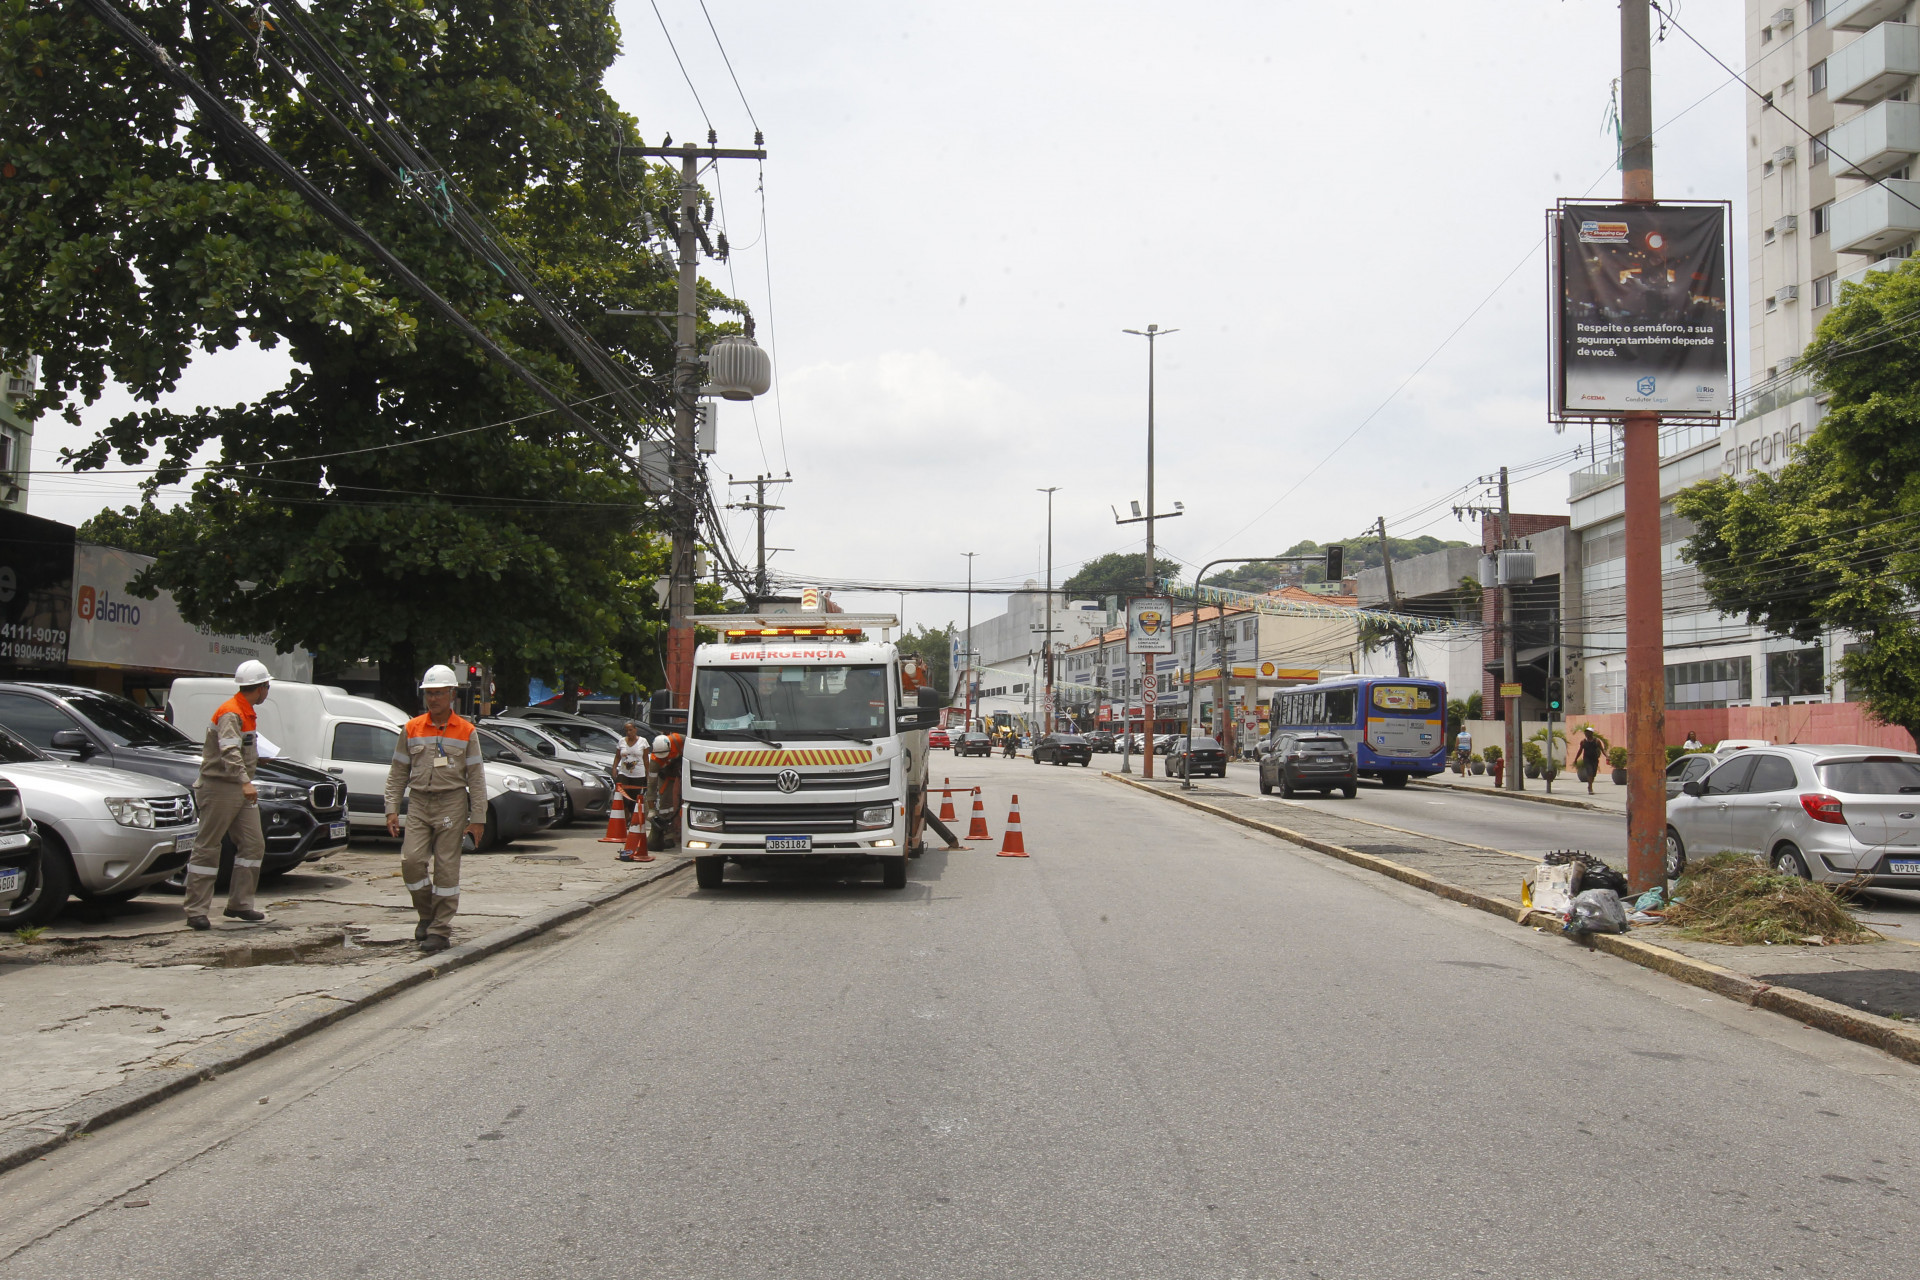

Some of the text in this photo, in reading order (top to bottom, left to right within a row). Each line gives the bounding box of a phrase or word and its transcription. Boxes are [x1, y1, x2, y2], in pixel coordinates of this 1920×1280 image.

[1577, 323, 1622, 333] Respeite
[1633, 323, 1686, 333] semáforo,
[1577, 336, 1714, 346] segurança também depende
[1577, 347, 1617, 357] de você.
[96, 590, 140, 625] álamo
[1, 623, 66, 644] 4111-9079
[1, 642, 66, 662] 21 99044-5541
[1787, 651, 1799, 667] 95
[769, 840, 807, 849] JBS1182
